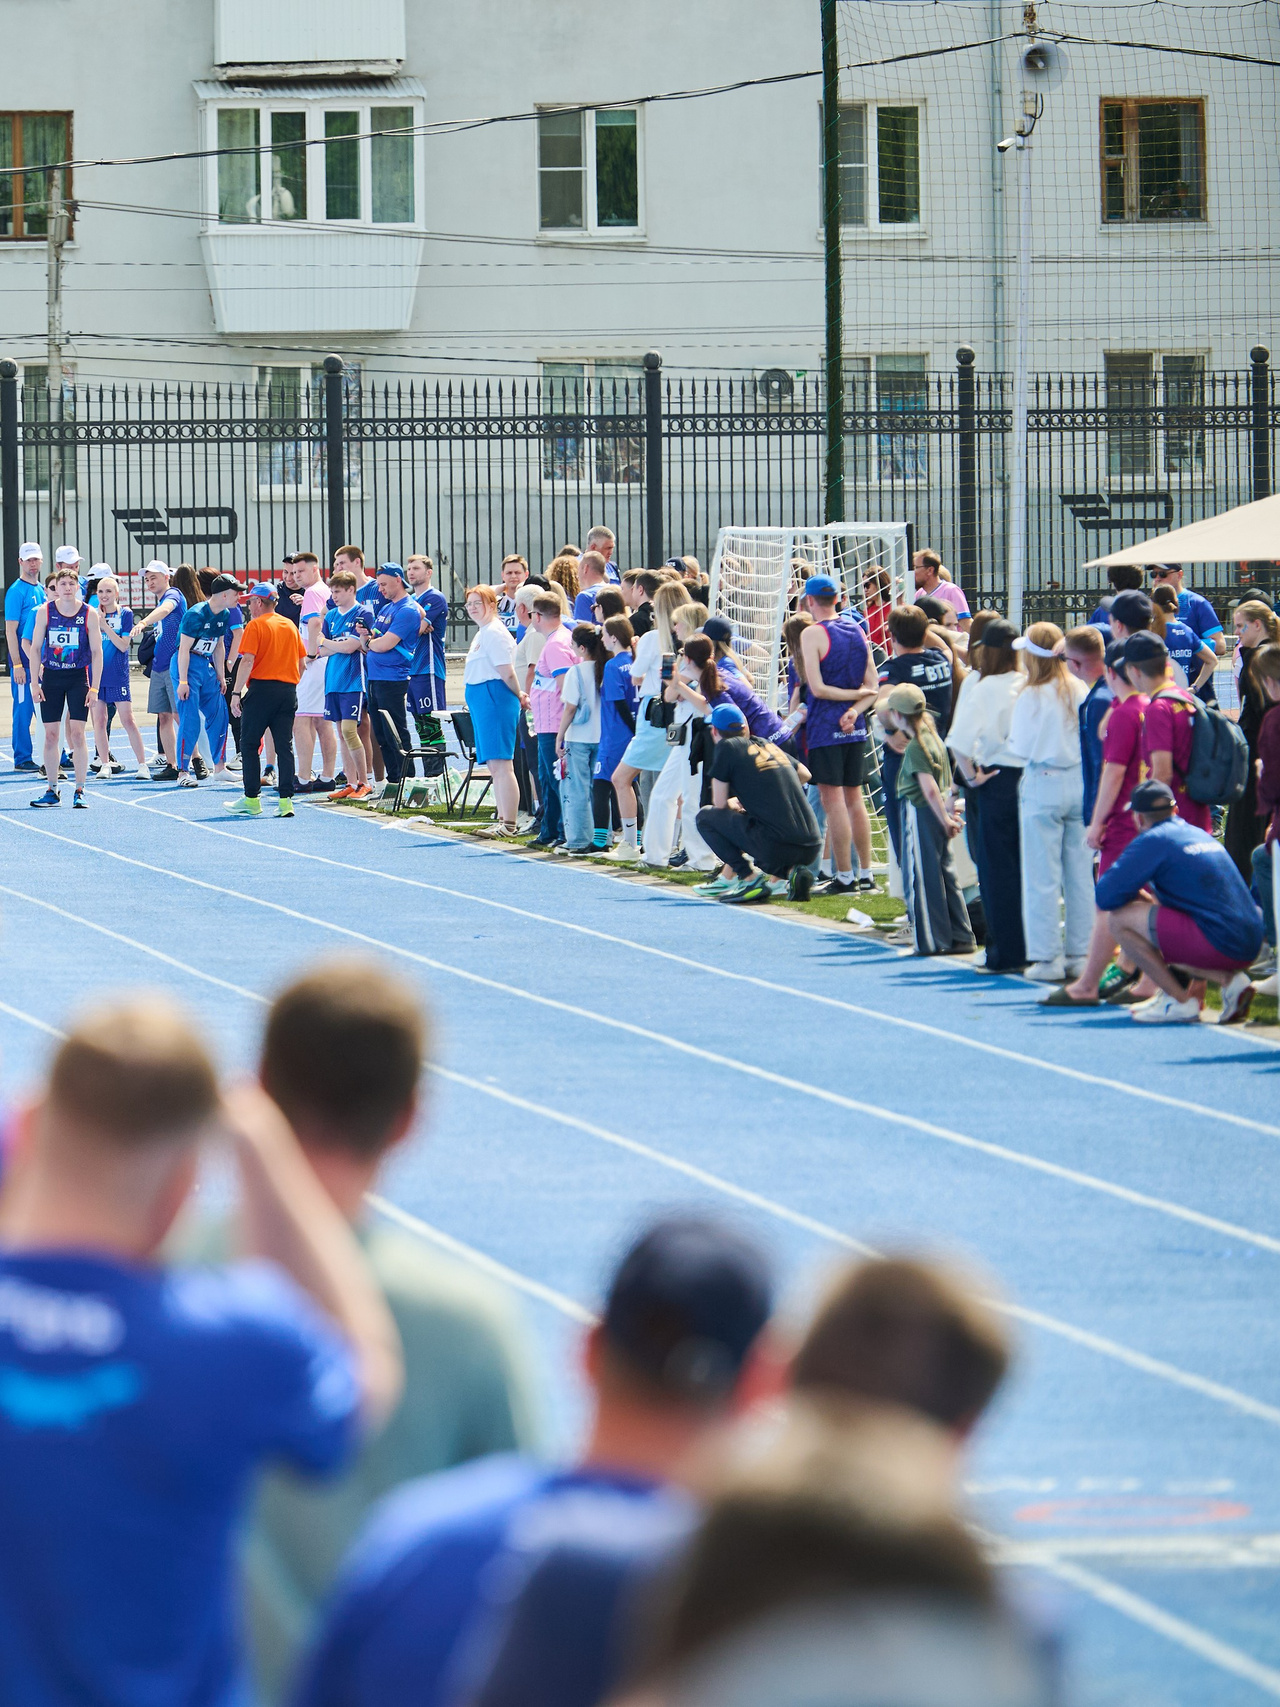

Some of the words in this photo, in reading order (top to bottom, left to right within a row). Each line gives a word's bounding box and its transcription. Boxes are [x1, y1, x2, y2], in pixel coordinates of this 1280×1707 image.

[75, 616, 84, 625] 28
[56, 633, 70, 644] 61
[925, 661, 951, 682] ВТБ
[121, 686, 128, 696] 5
[419, 696, 432, 709] 10
[351, 705, 359, 716] 2
